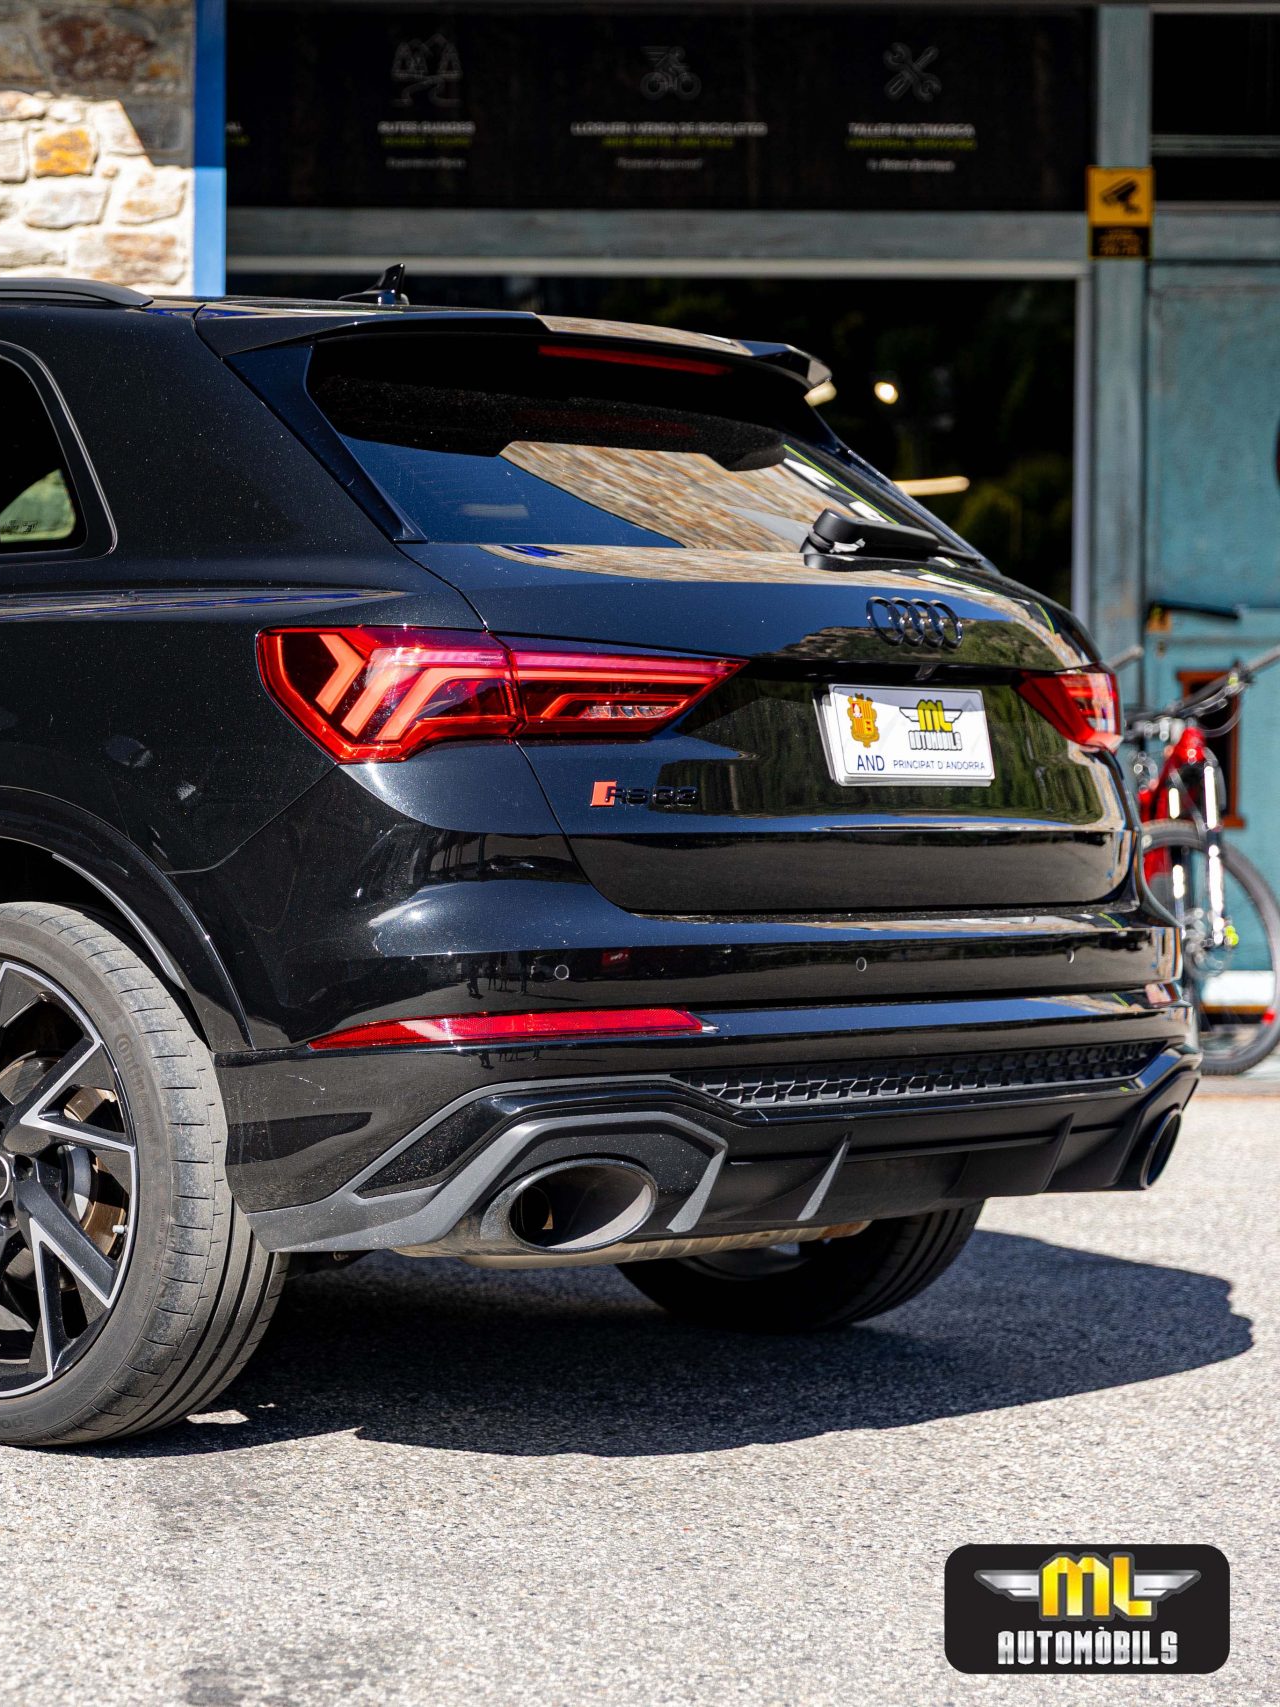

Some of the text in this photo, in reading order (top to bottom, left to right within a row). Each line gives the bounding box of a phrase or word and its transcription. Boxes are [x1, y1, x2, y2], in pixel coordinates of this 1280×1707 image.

[917, 699, 953, 732] ML
[857, 754, 885, 772] AND
[893, 759, 935, 770] PRINCIPAT
